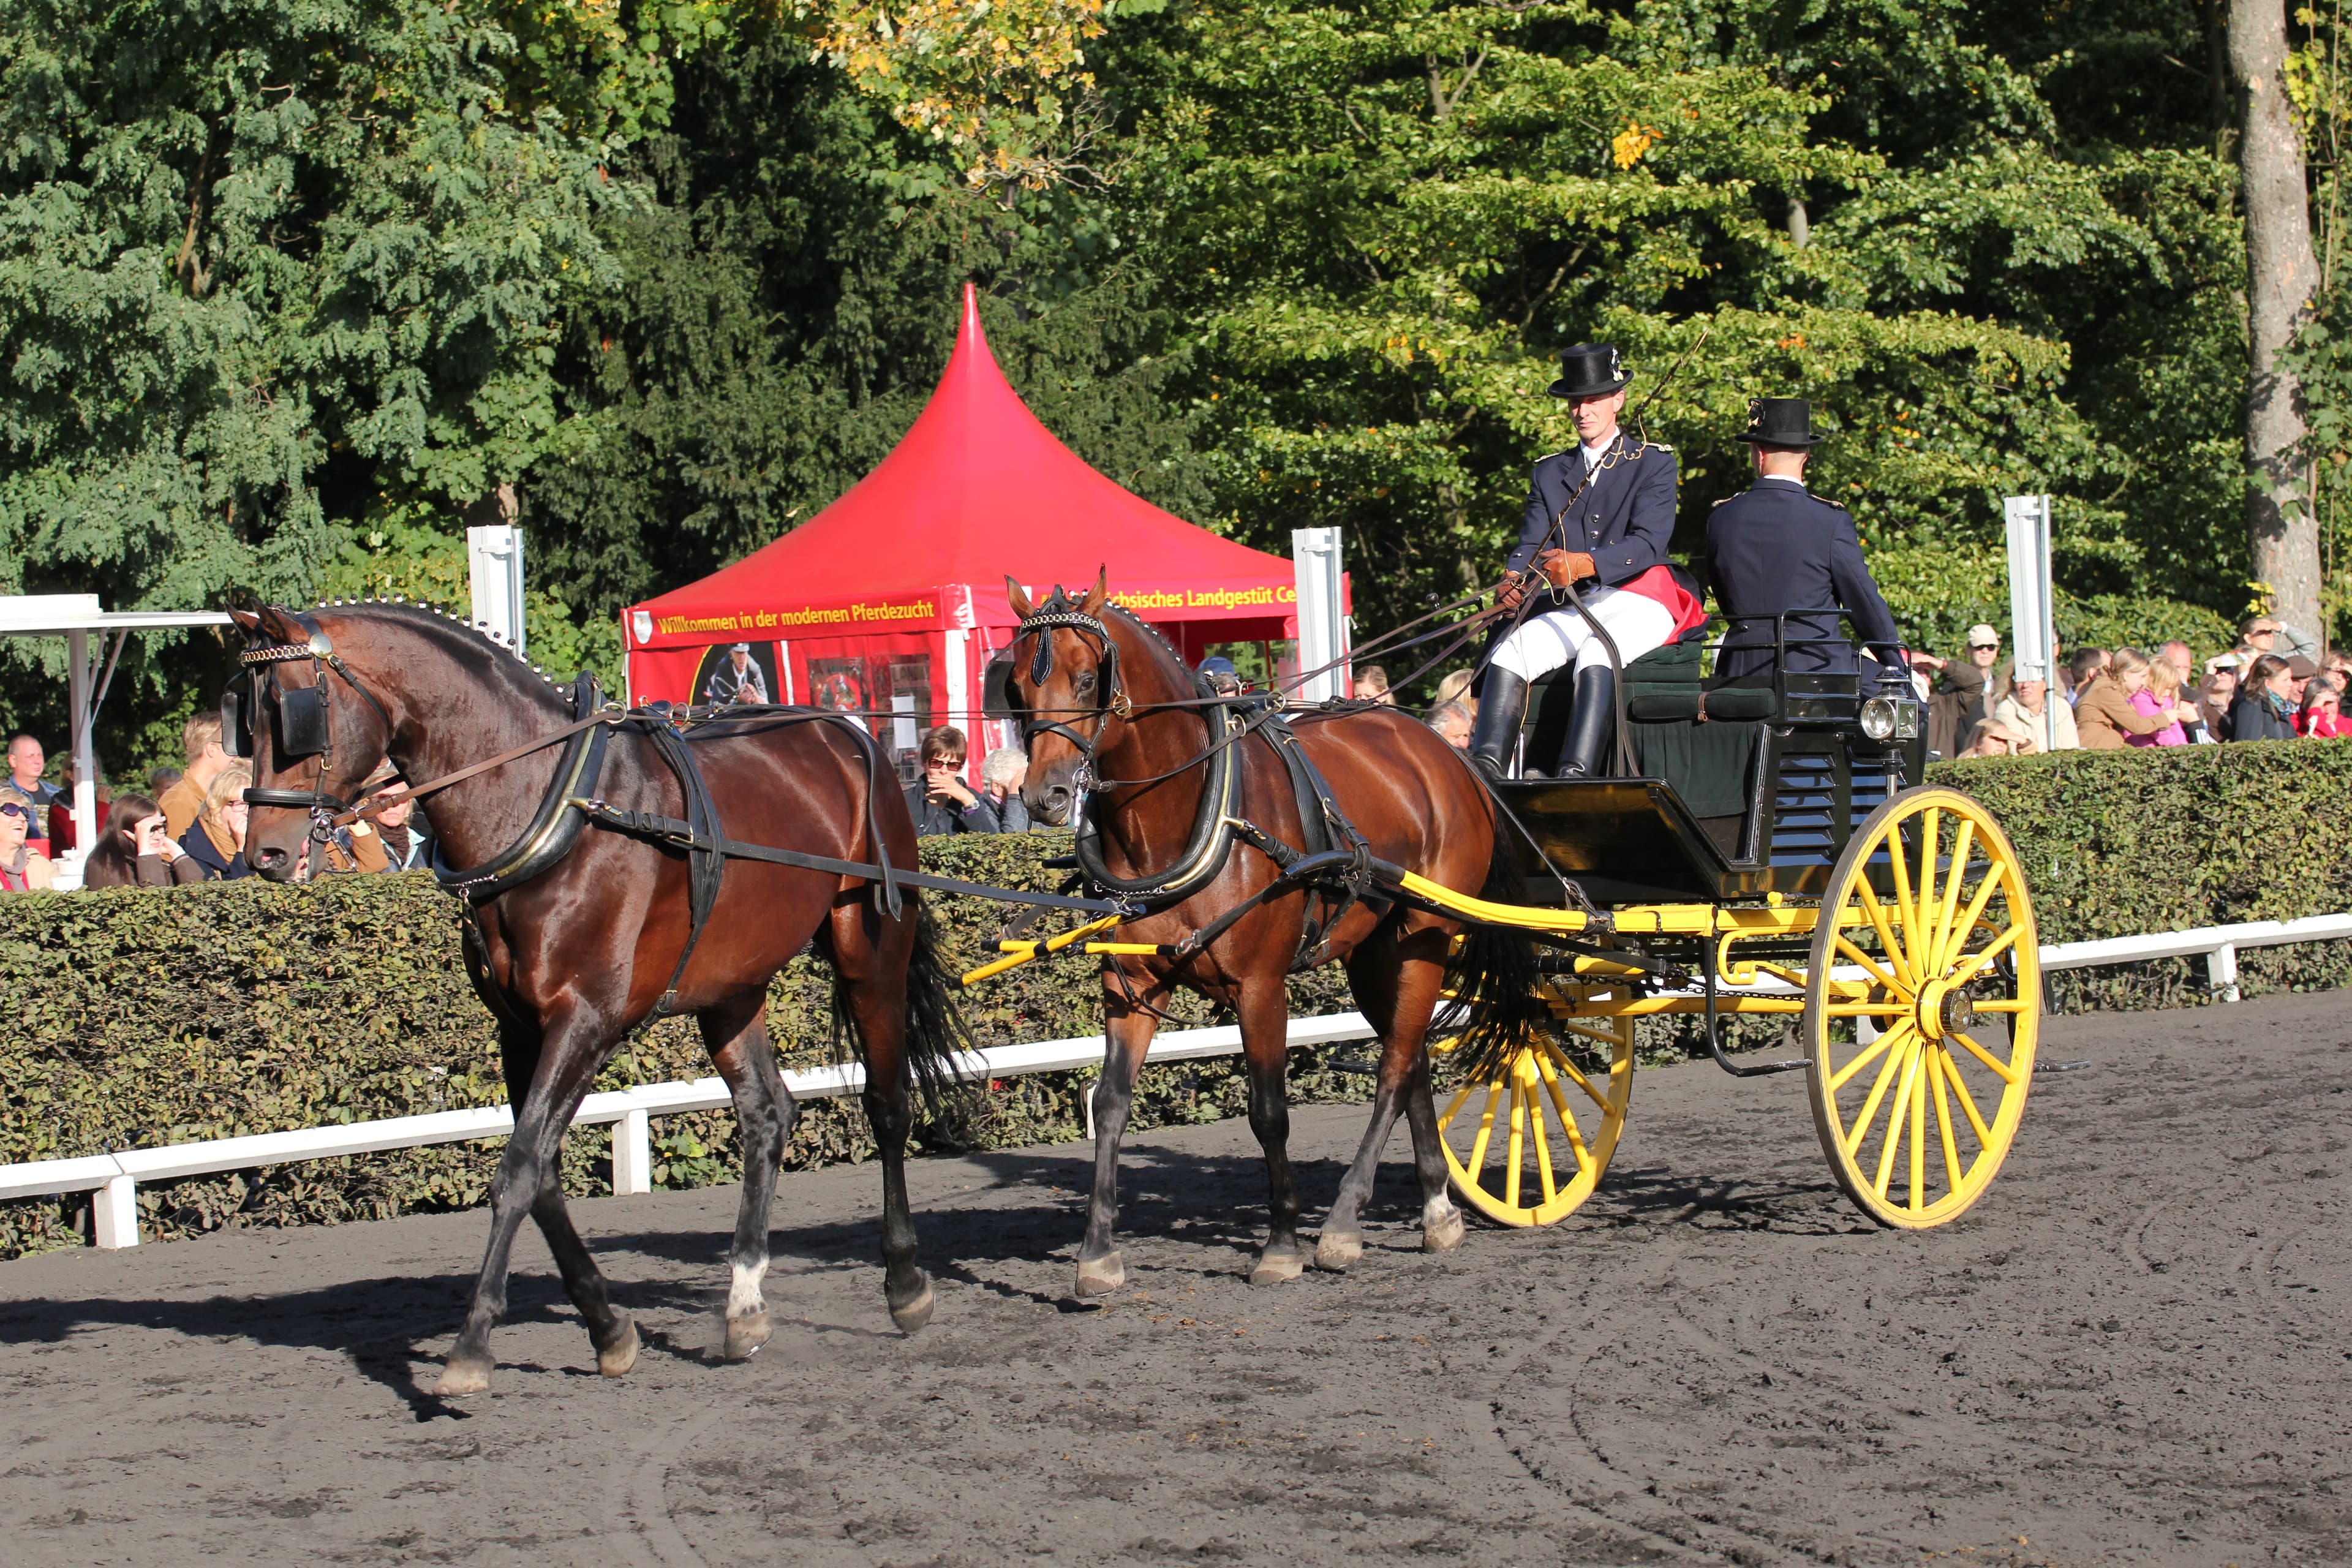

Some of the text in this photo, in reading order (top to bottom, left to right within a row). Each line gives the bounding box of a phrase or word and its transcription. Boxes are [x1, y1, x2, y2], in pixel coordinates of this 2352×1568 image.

[1186, 587, 1273, 610] Landgestüt
[1276, 586, 1298, 603] Ce
[658, 600, 934, 635] Willkommen in der modernen Pferdezucht
